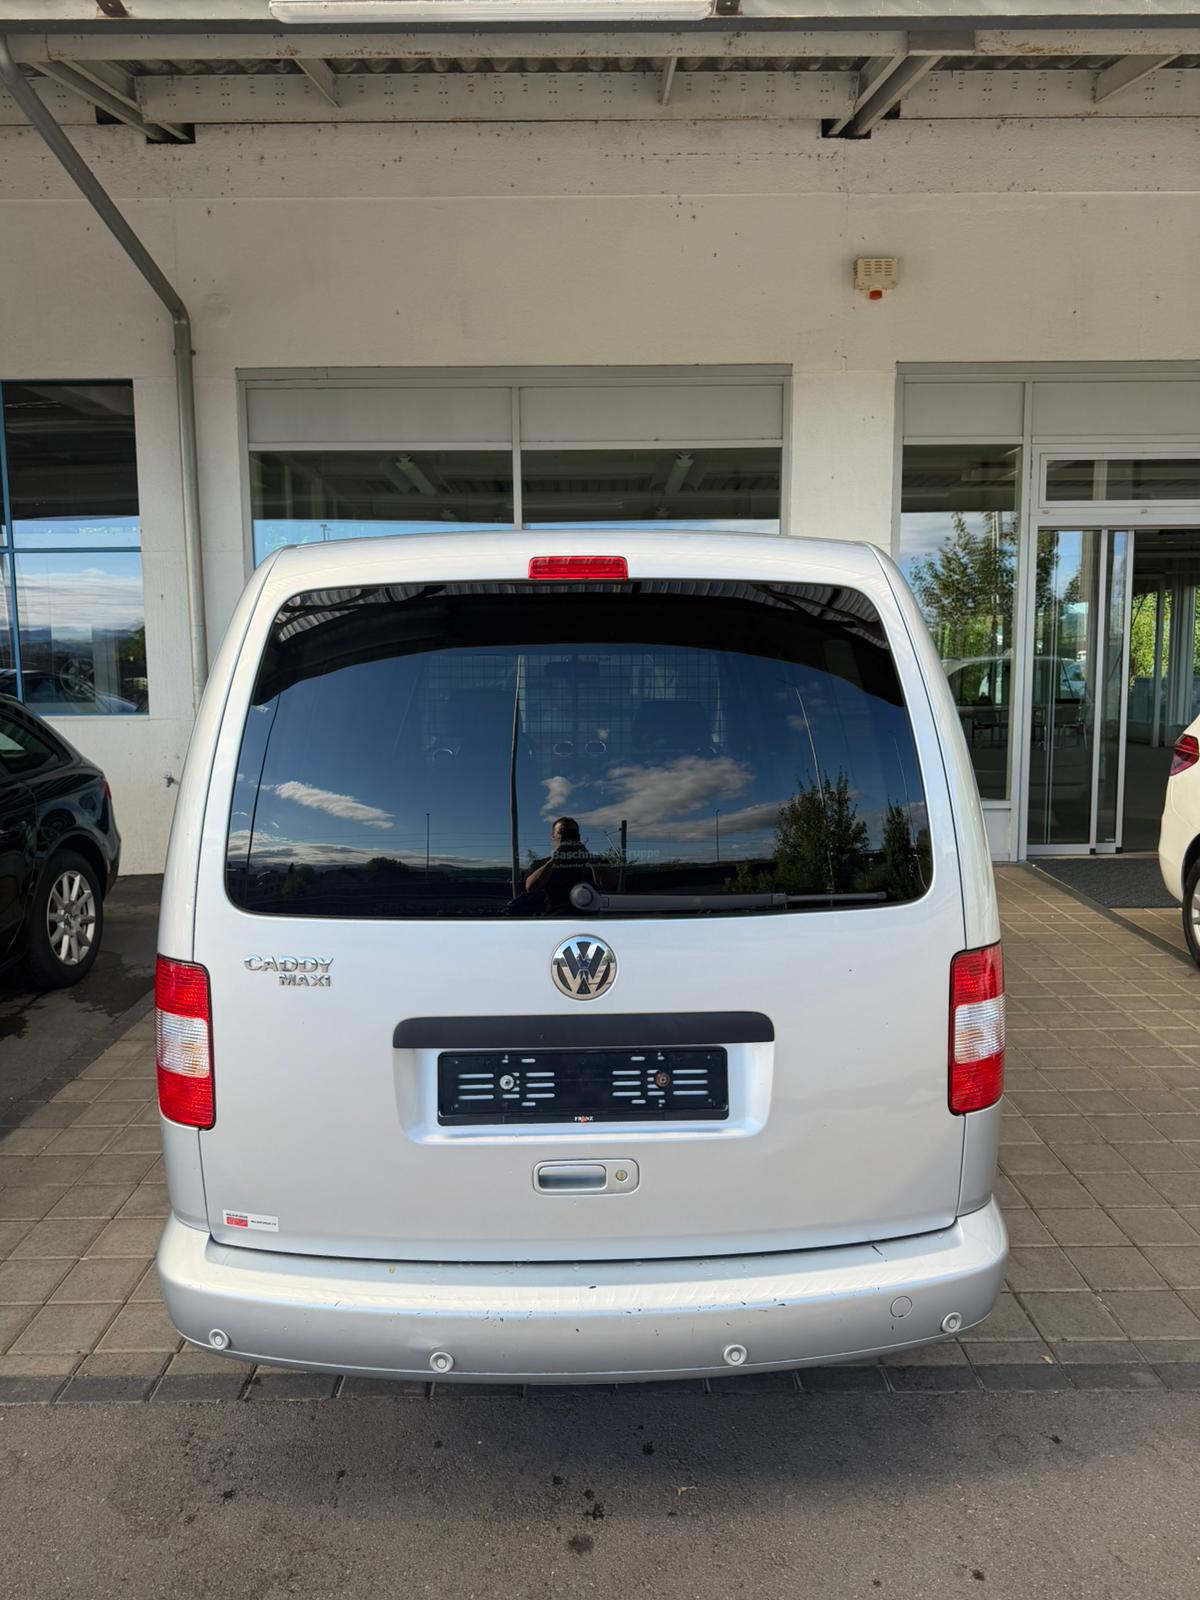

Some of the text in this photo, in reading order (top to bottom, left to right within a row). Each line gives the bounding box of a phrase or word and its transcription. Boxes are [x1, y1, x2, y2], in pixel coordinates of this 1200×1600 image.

[244, 953, 334, 973] CADDY
[551, 934, 617, 1001] VW
[279, 973, 331, 987] MAXI
